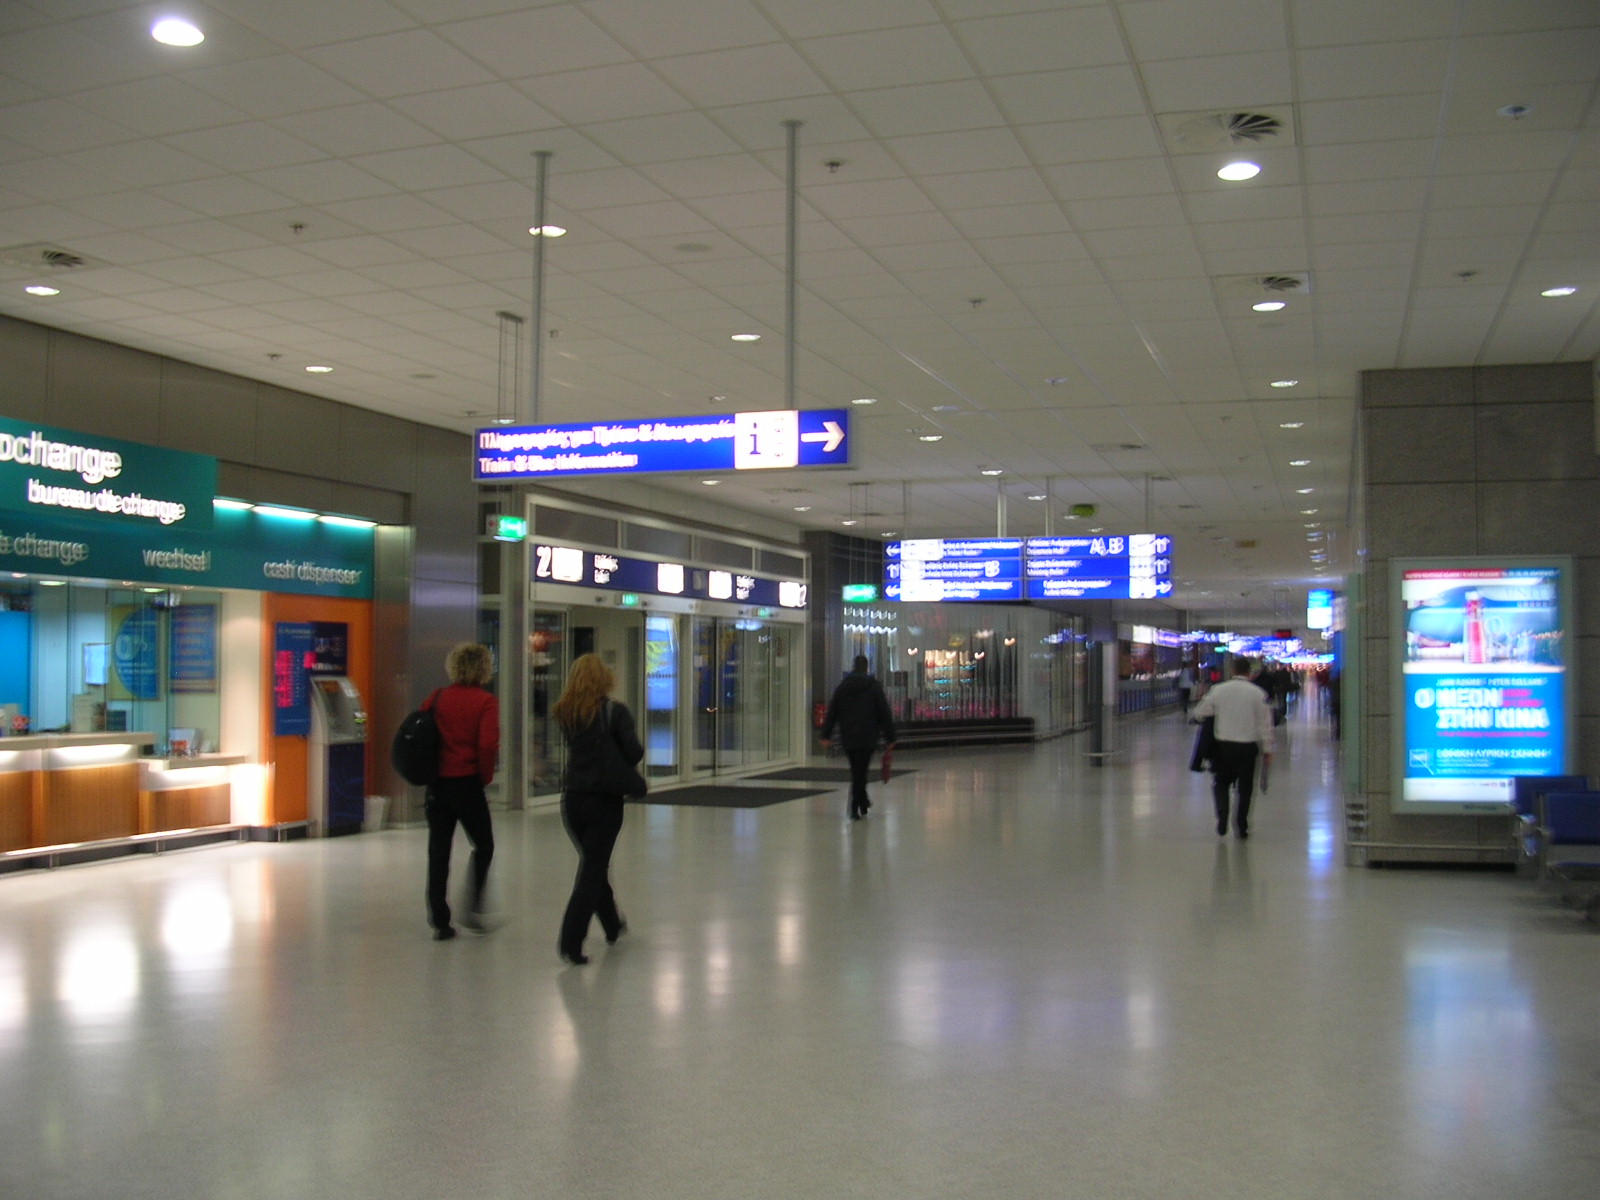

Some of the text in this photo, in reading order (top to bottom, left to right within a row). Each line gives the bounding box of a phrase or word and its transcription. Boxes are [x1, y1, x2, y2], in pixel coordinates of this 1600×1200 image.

[479, 457, 515, 473] Train
[556, 451, 638, 471] Information
[28, 478, 187, 525] bureau de change
[13, 531, 91, 566] change
[142, 547, 212, 572] wechsel
[263, 558, 363, 586] cash dispenser
